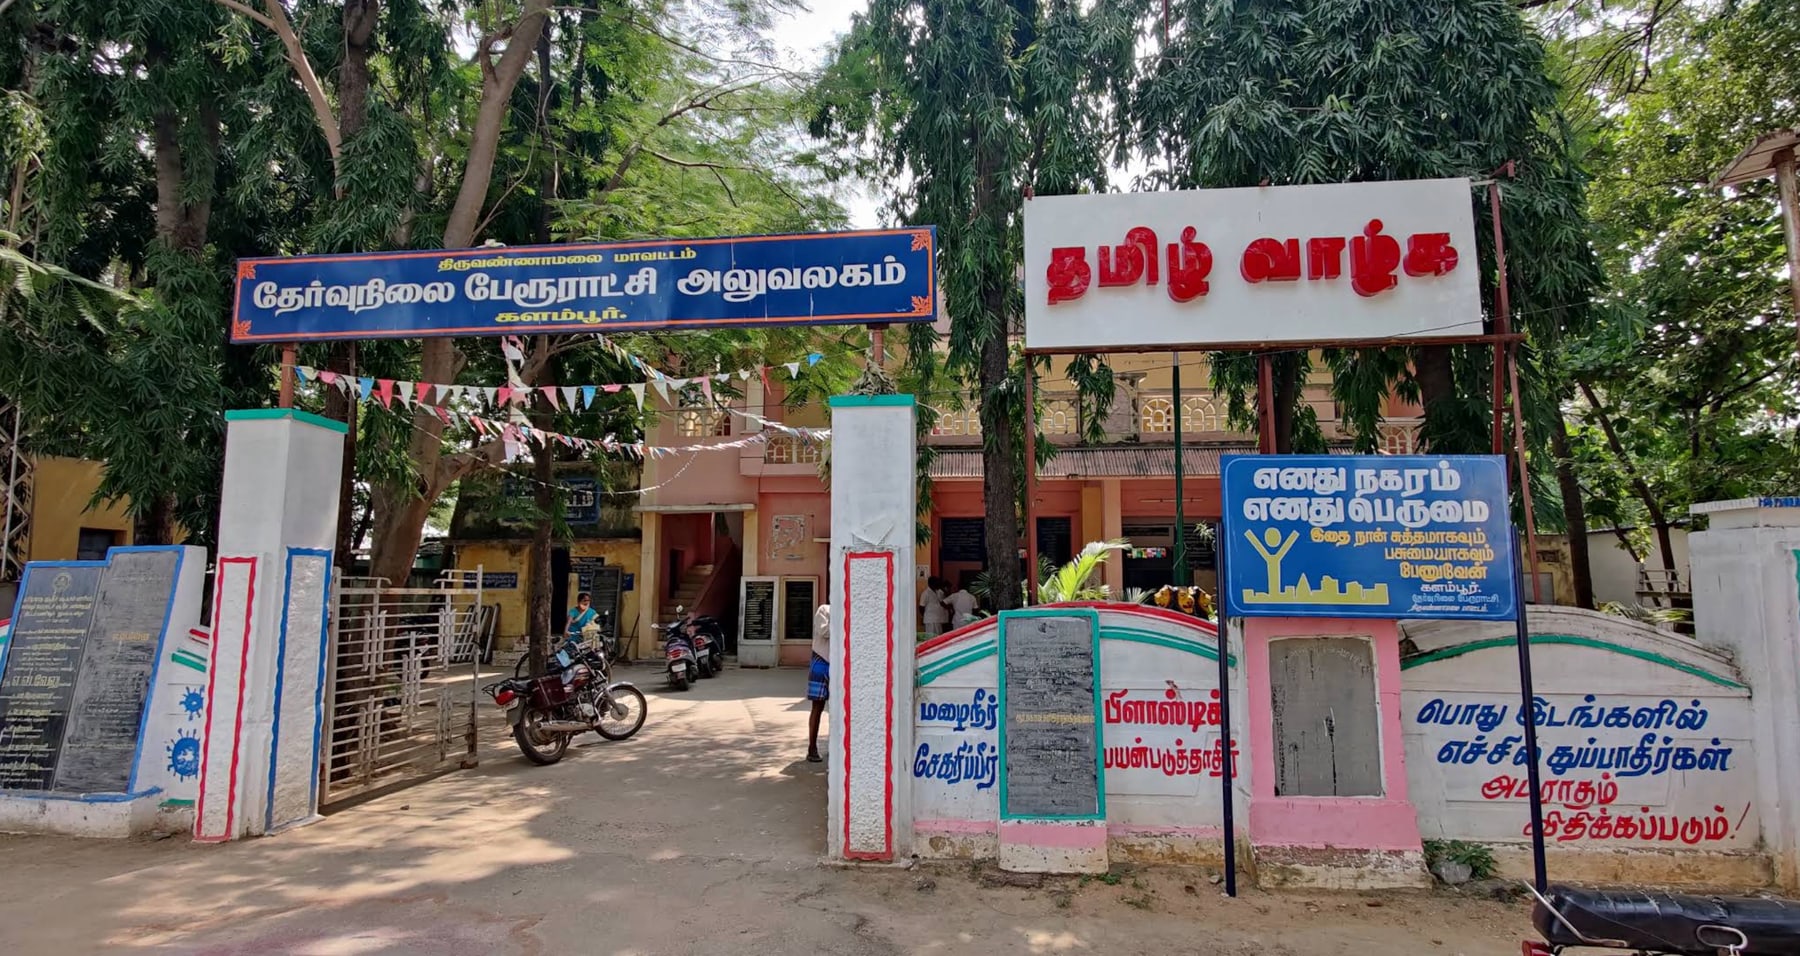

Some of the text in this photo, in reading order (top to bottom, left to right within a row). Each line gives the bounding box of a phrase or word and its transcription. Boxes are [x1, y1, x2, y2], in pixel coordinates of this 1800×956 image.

[438, 247, 697, 272] திருவண்ணாமலை மாவட்டம்
[1046, 218, 1459, 305] தமிழ் வாழ்க
[253, 255, 907, 317] தேர்வுநிலை பேரூராட்சி அலுவலகம்
[495, 306, 628, 324] களம்பூர்.
[1253, 460, 1461, 498] எனது நகரம்
[1243, 497, 1490, 528] எனது பெருமை
[1310, 526, 1487, 548] இதை நான் சுத்தமாகவும்
[1384, 543, 1495, 564] பசுமையாகவும்
[920, 688, 999, 732] மழைநீர்
[1105, 688, 1222, 733] பிளாஸ்டிக்
[1416, 694, 1708, 733] பொது இடங்களில்
[913, 740, 998, 791] சேகரிப்பீர்
[1546, 732, 1733, 778] துப்பாதீர்கள்
